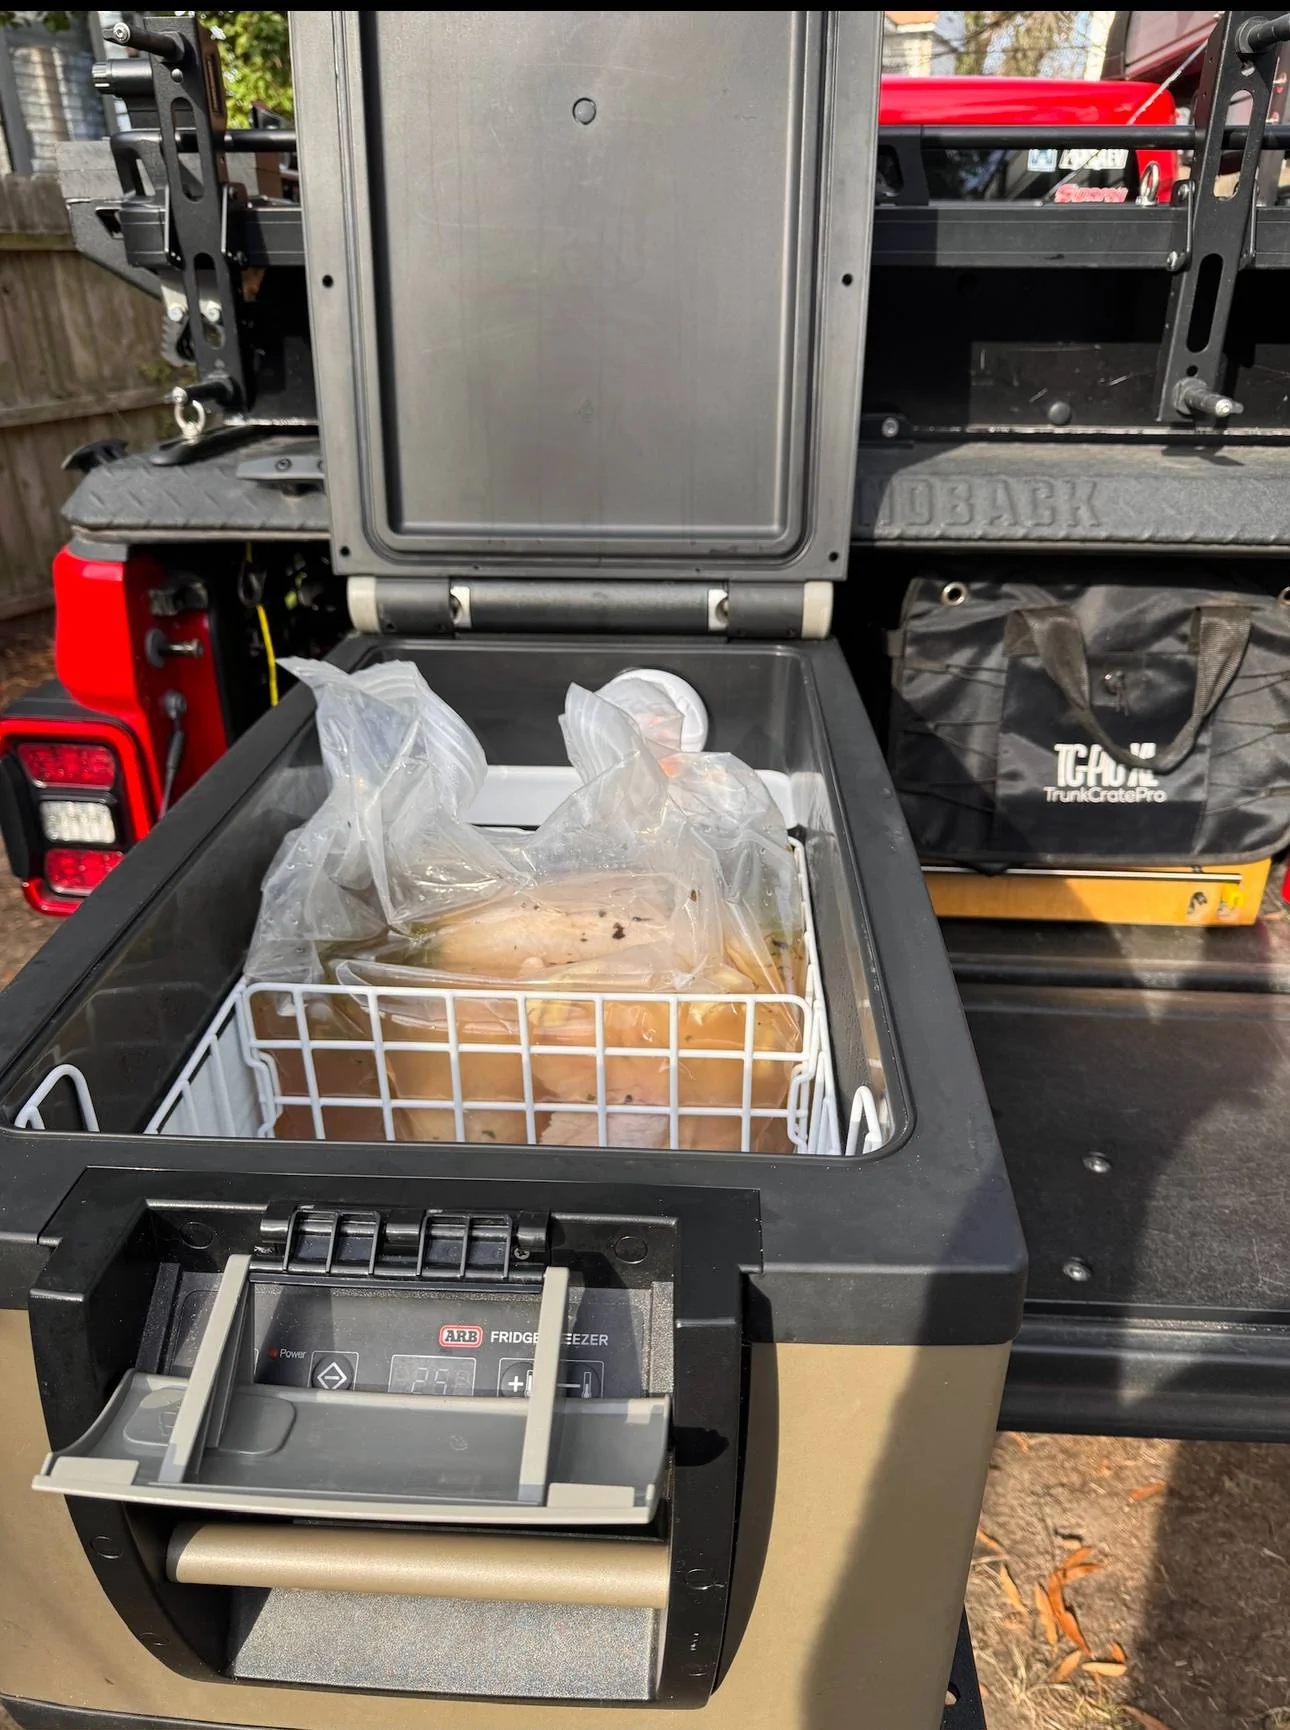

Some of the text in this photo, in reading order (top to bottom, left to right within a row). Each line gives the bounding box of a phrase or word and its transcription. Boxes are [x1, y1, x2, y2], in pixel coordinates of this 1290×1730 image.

[1043, 786, 1168, 803] TrunkCratePro
[443, 1328, 609, 1346] ARB FRIDGE EEZER
[280, 1348, 306, 1359] Power
